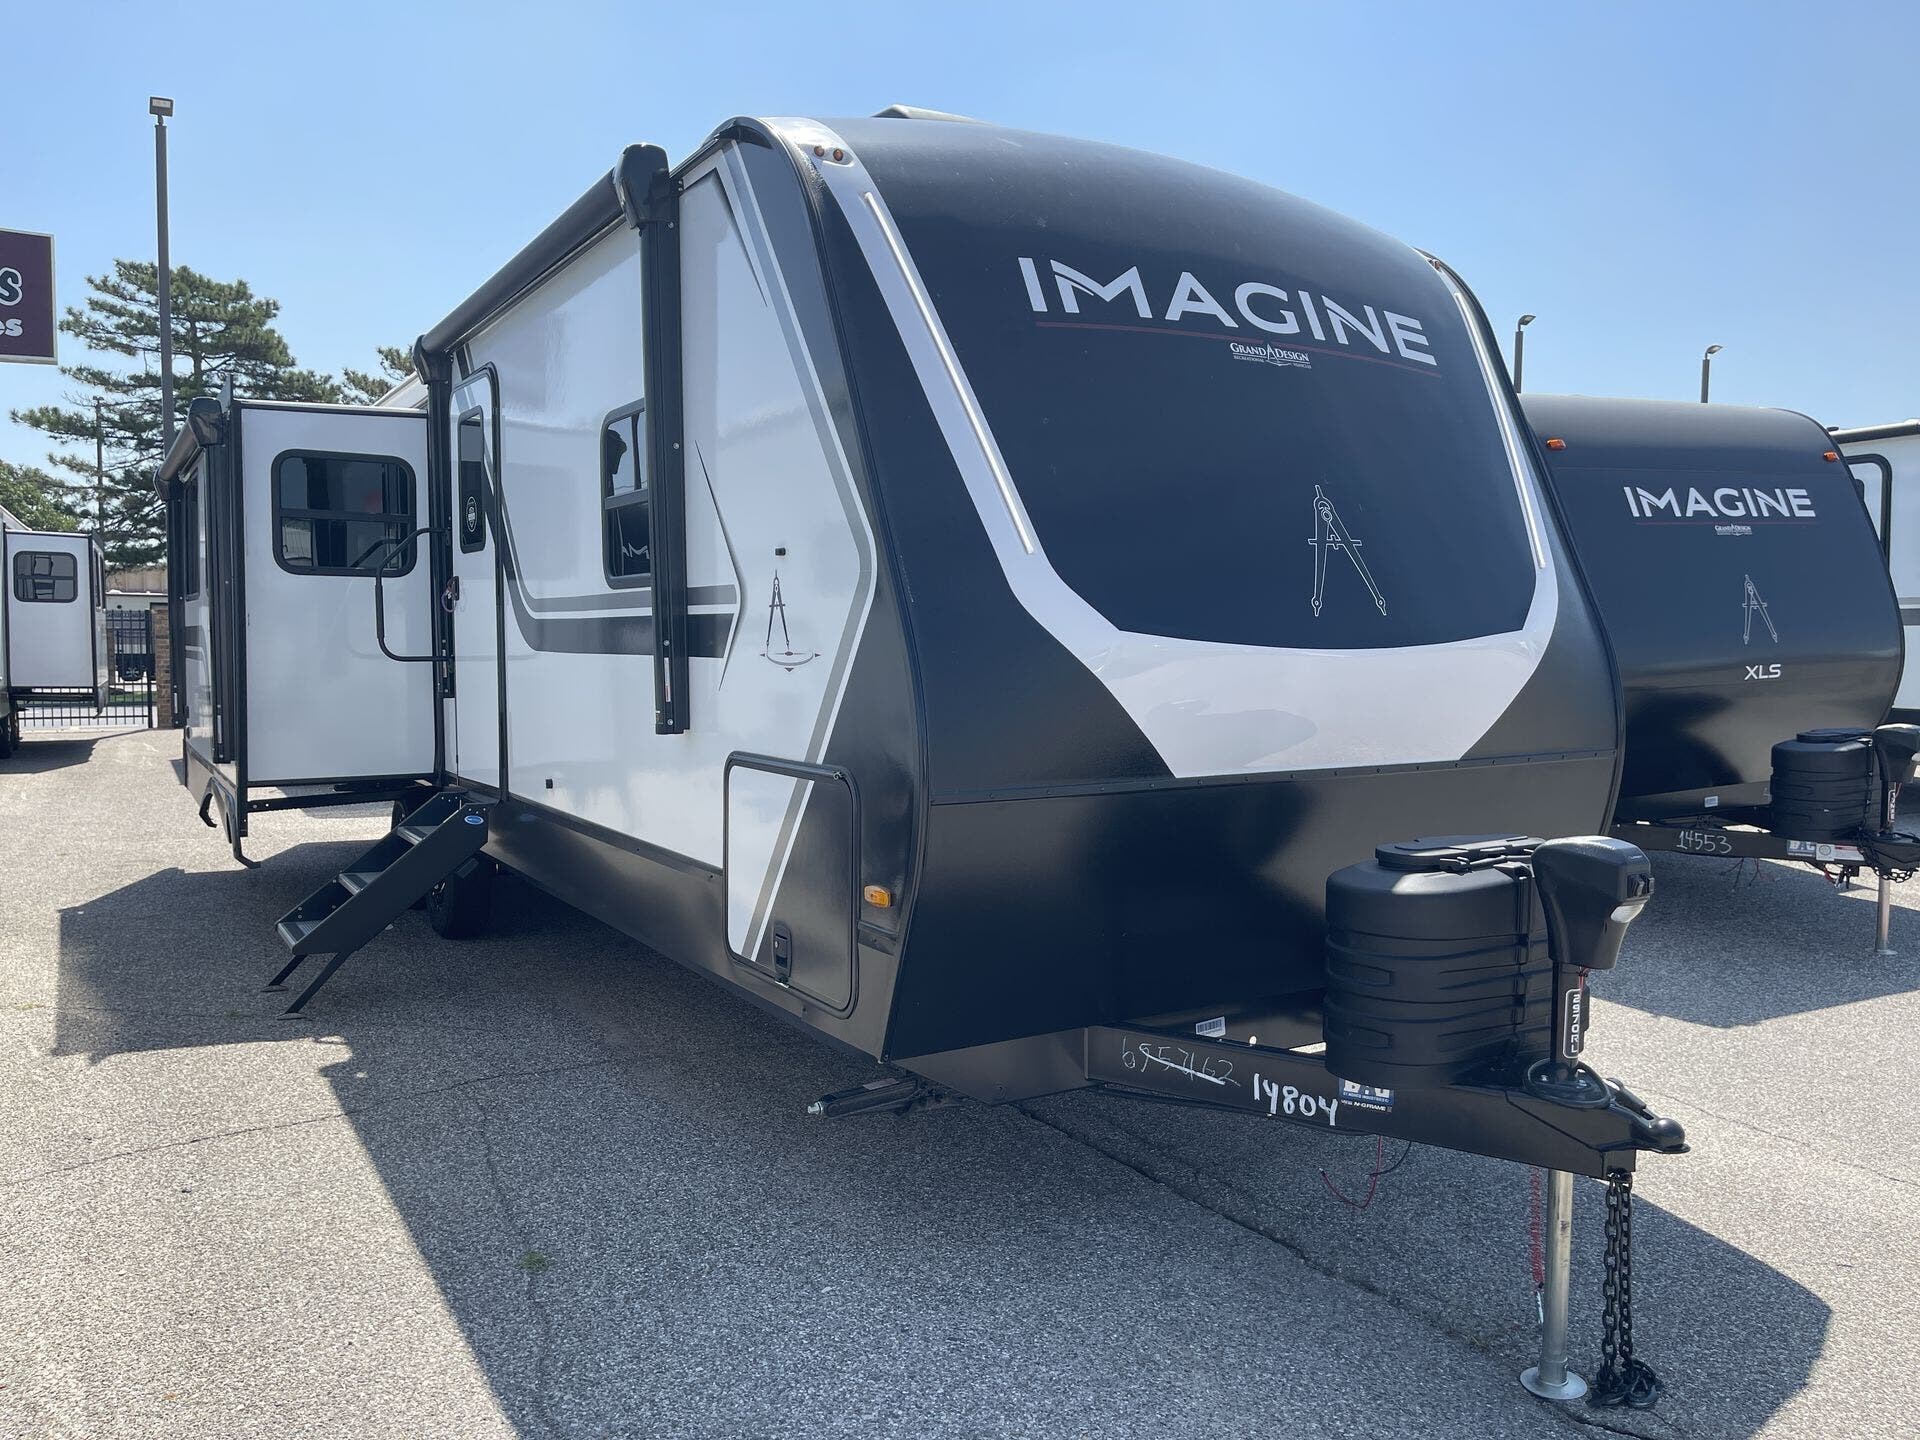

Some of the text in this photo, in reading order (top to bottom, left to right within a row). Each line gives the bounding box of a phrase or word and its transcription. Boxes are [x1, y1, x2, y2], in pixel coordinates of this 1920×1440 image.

[1018, 256, 1438, 366] IMAGINE
[1230, 342, 1310, 362] GRAND DESIGN
[1623, 486, 1816, 517] IMAGINE
[1744, 664, 1781, 681] XLS
[1676, 830, 1732, 854] 14553
[1254, 1073, 1338, 1126] 14804
